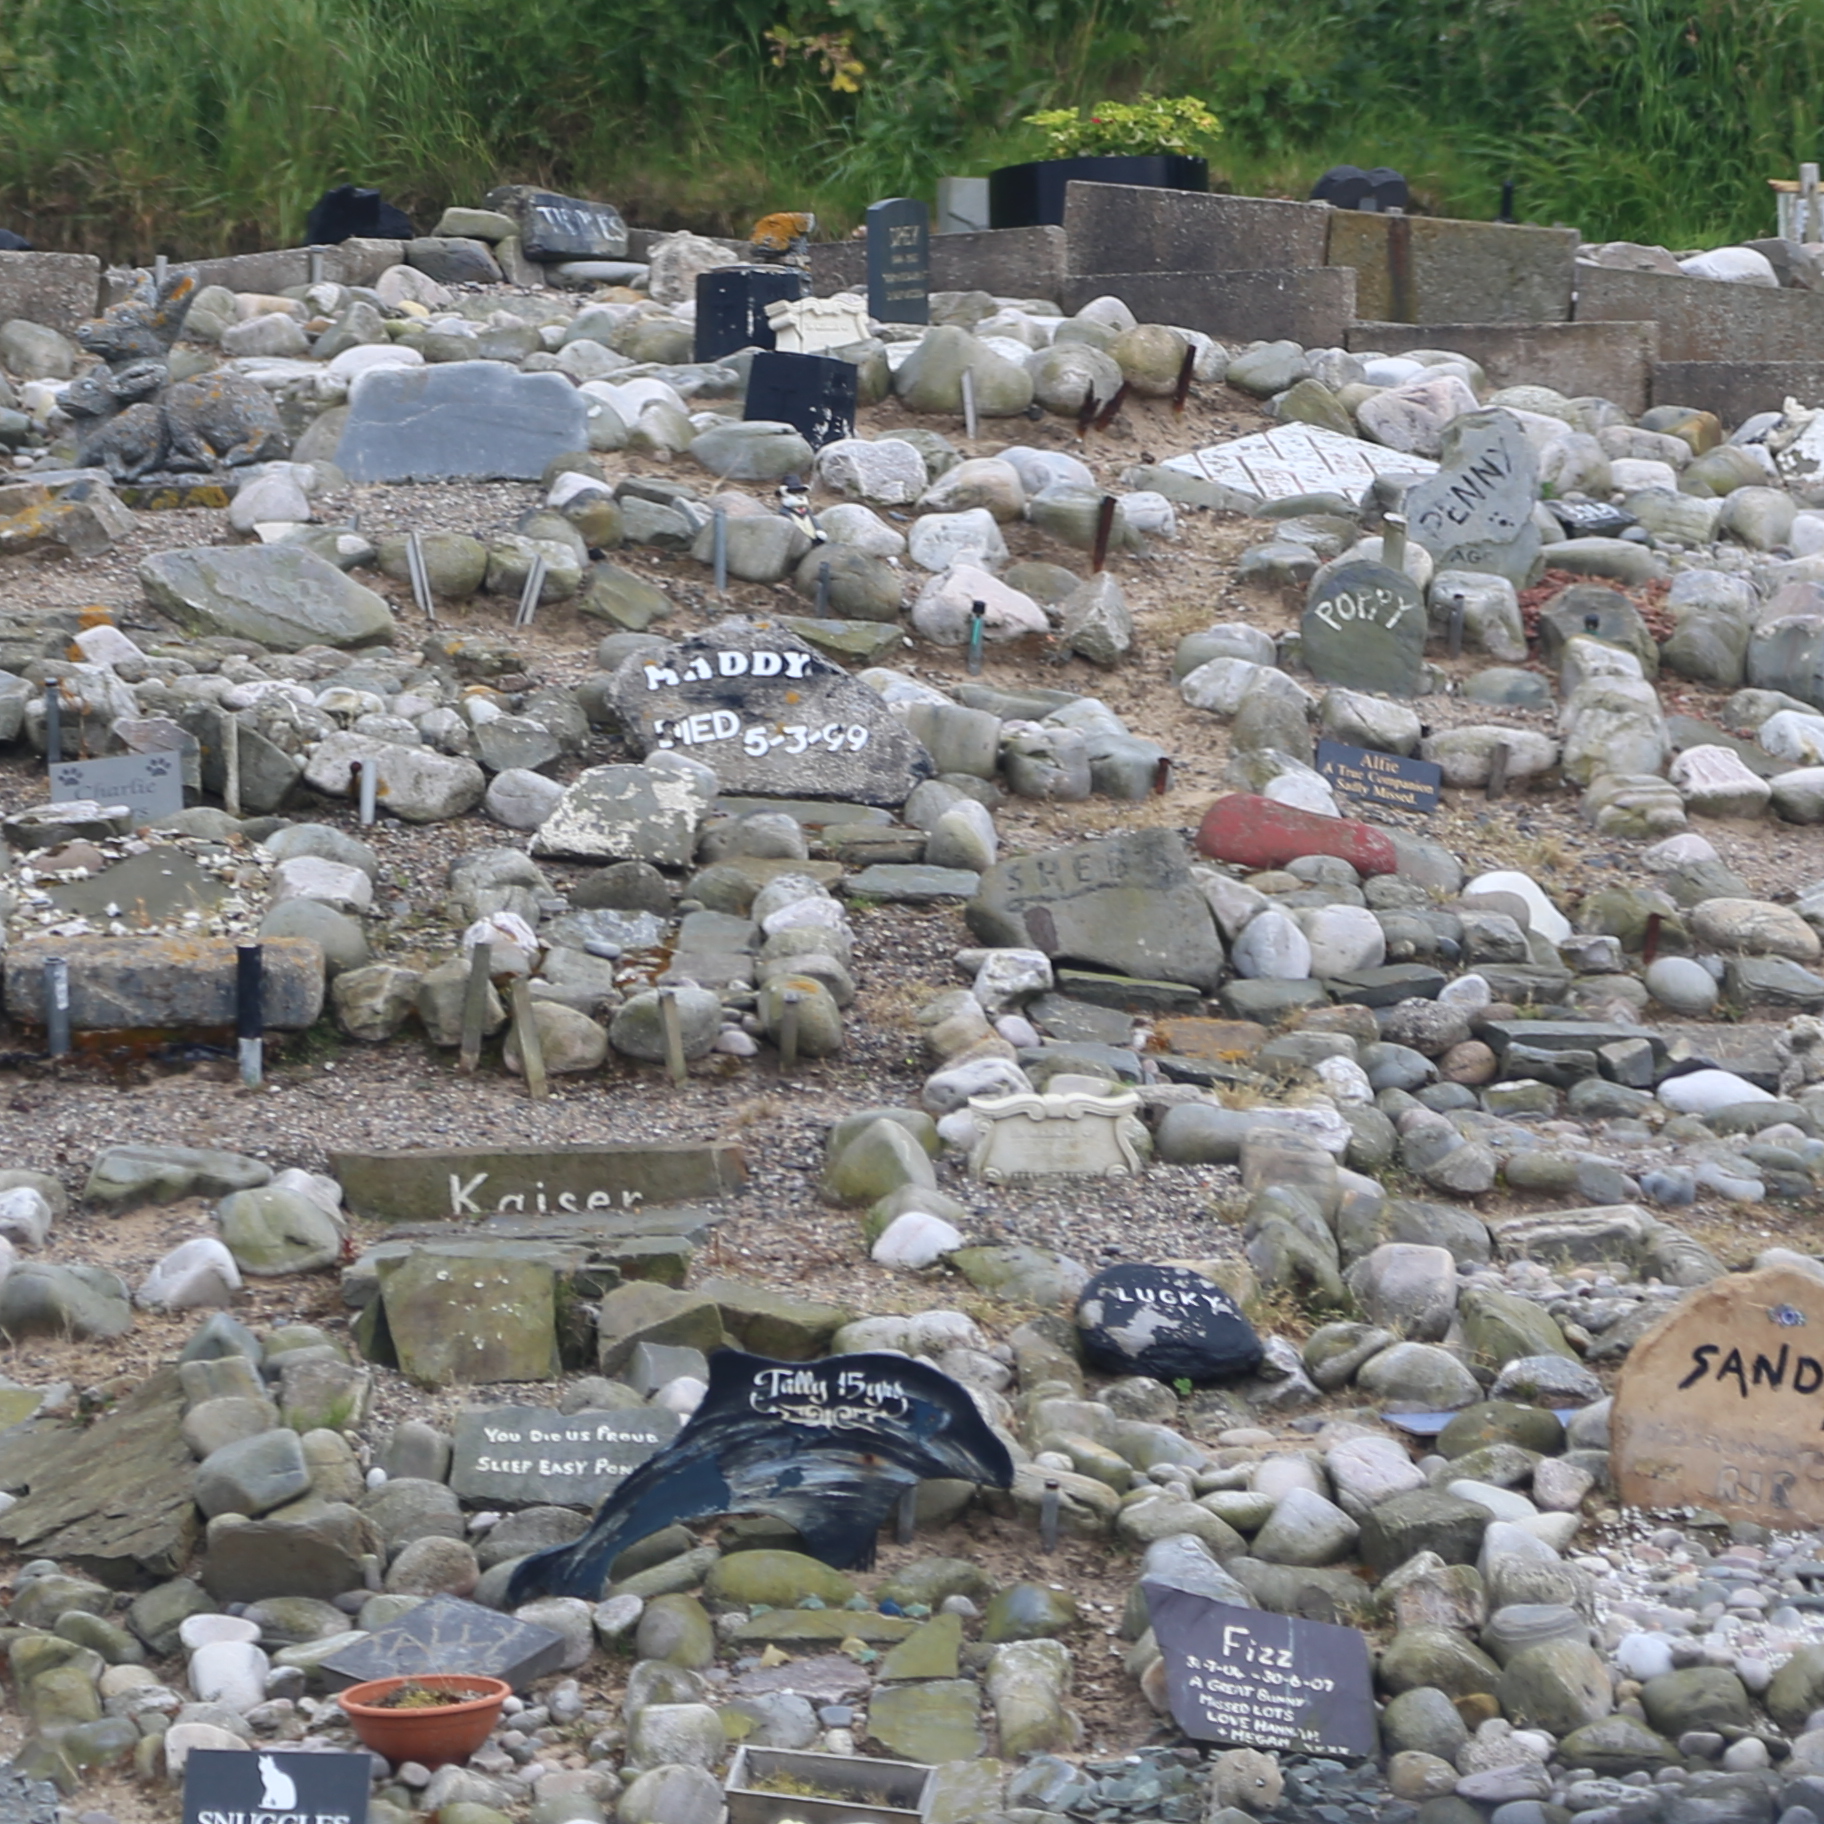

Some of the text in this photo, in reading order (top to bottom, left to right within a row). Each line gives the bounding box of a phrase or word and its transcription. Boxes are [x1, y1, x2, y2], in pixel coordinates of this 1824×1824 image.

[1315, 588, 1415, 632] POPPY
[644, 650, 811, 691] MADDY
[654, 709, 870, 757] DIED 5-3-99
[1359, 752, 1400, 775] Alfie
[74, 778, 157, 800] Charlie
[1323, 761, 1434, 795] A True Companion
[1336, 778, 1370, 798] Sadly
[449, 1172, 644, 1215] Kaiser
[753, 1368, 828, 1405] Tally
[476, 1456, 533, 1475] SLEEP
[538, 1458, 588, 1476] EASY
[1222, 1625, 1294, 1668] Fizz
[1189, 1675, 1204, 1689] A
[1206, 1711, 1252, 1729] LOVE
[1252, 1705, 1295, 1723] LOTS
